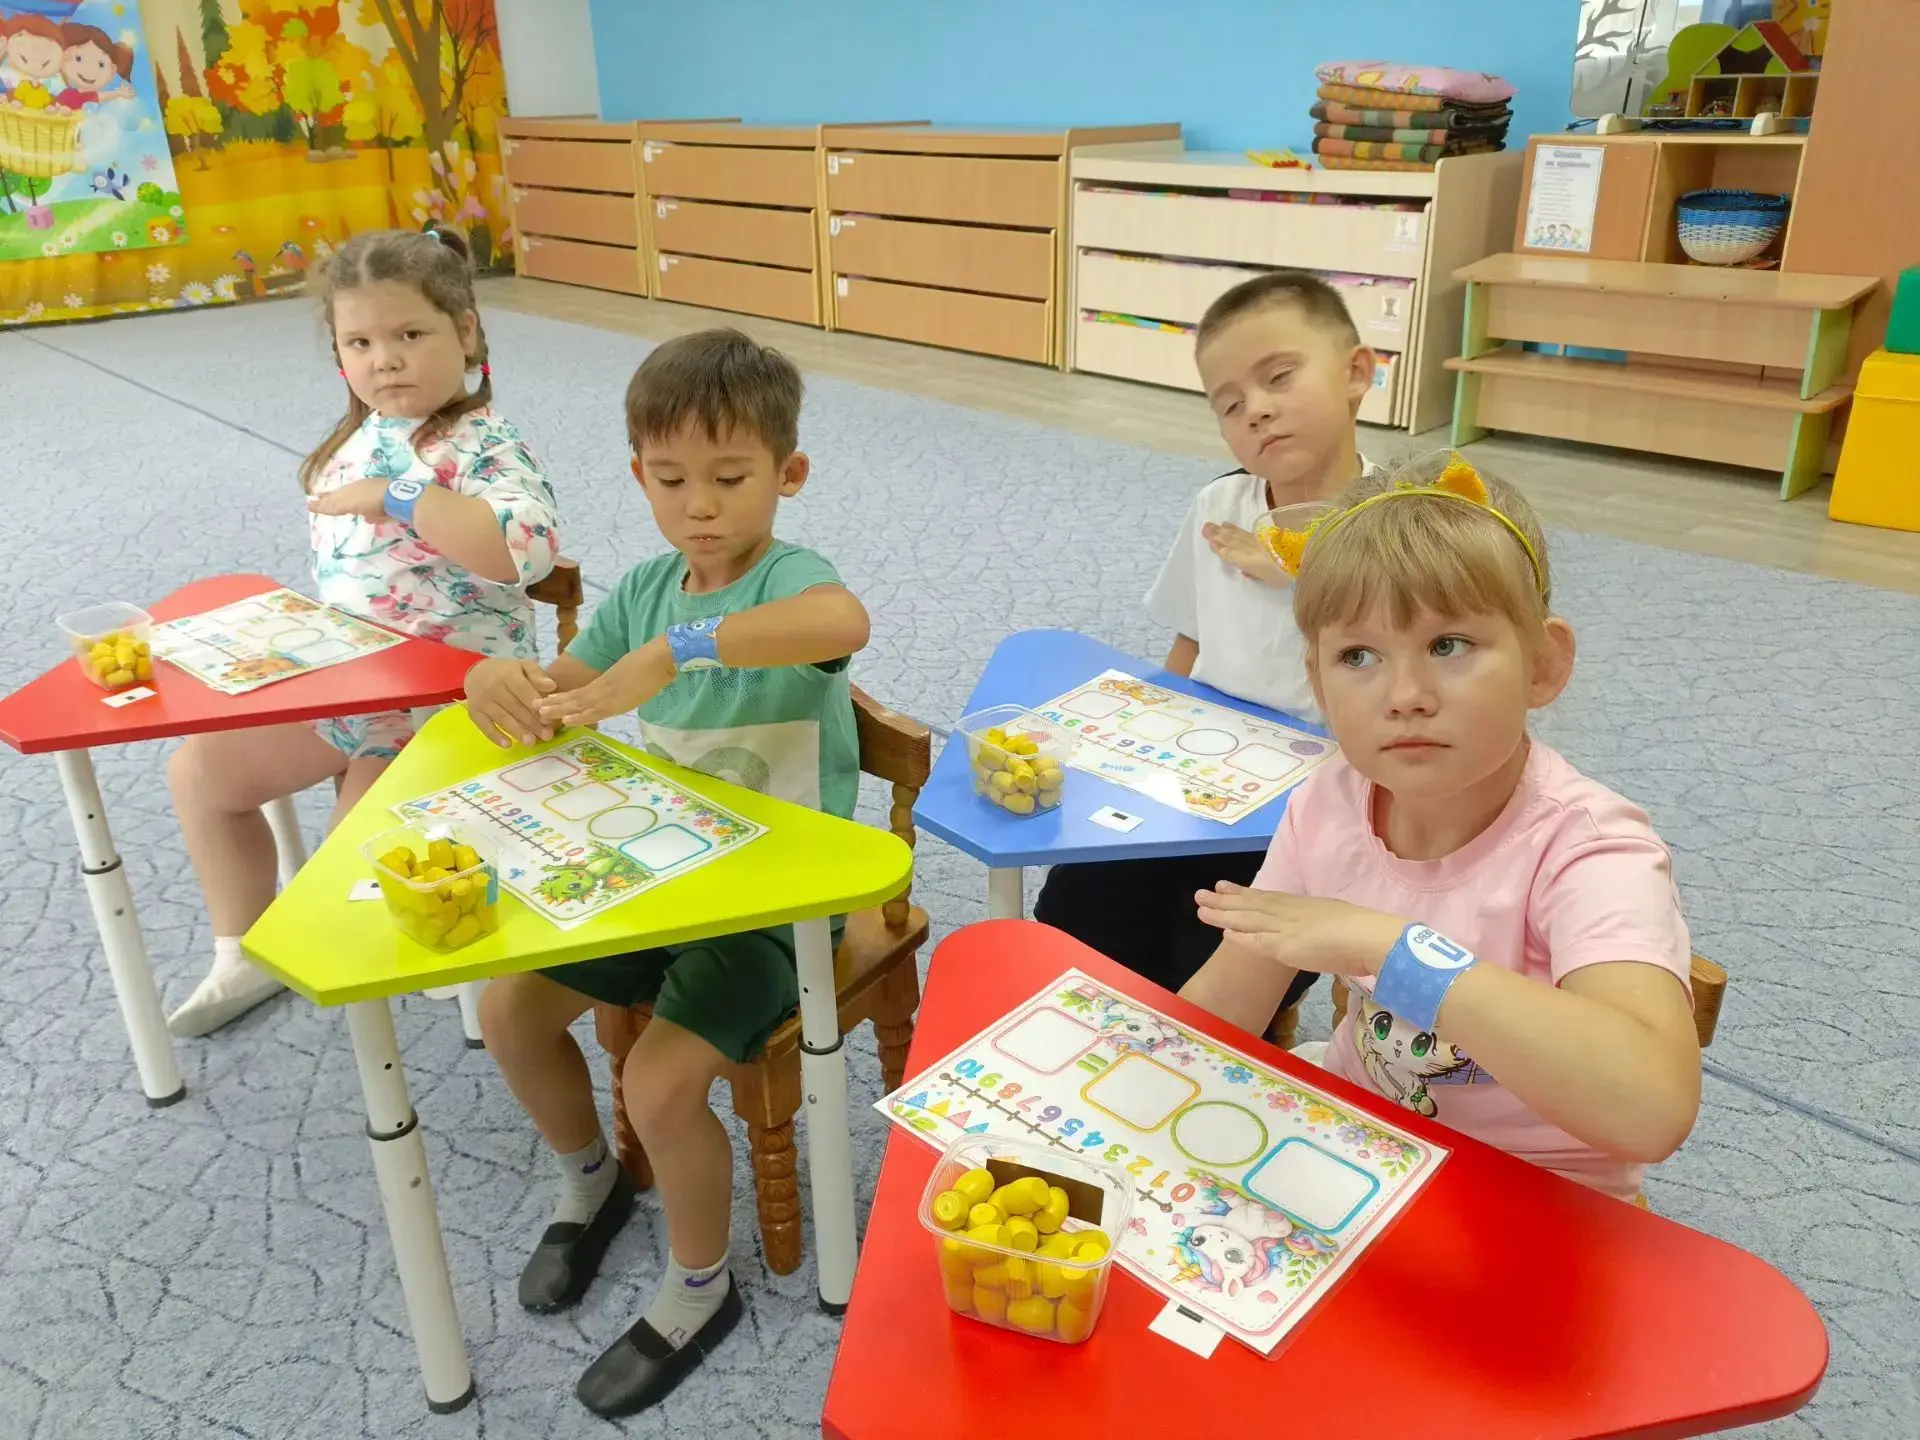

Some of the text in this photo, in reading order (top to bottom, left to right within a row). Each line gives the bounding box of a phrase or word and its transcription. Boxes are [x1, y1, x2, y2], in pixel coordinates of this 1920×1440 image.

[1064, 719, 1082, 727] 9
[1081, 725, 1099, 734] 8
[1117, 739, 1135, 747] 6
[1136, 745, 1155, 754] 5
[1157, 752, 1175, 760] 4
[1179, 759, 1197, 768] 3
[1200, 767, 1219, 775] 2
[1221, 774, 1236, 783] 1
[1241, 782, 1260, 792] 0
[462, 783, 584, 856] 0 1 2 3 4 5 6 7 8 9 10
[955, 1059, 1195, 1202] 0 1 2 3 4 5 6 7 8 9 10
